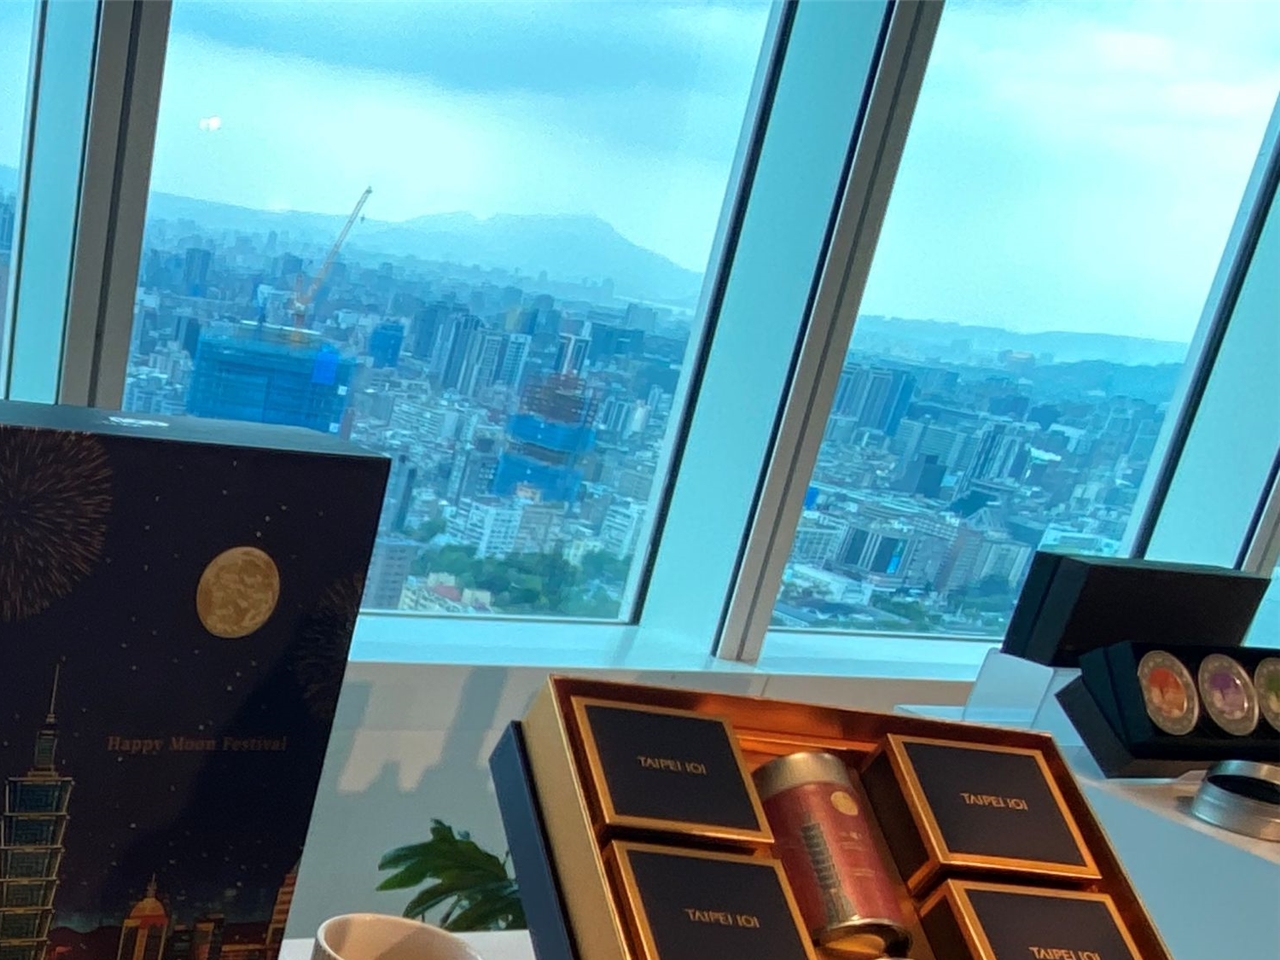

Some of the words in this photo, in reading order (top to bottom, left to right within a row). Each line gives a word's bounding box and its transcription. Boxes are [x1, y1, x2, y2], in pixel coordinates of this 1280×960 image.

[106, 735, 164, 755] Happy
[168, 736, 217, 752] Moon
[221, 735, 288, 752] Festival
[637, 755, 681, 772] TAIPEI
[960, 792, 1006, 808] TAIPEI
[685, 908, 732, 926] TAIPEI
